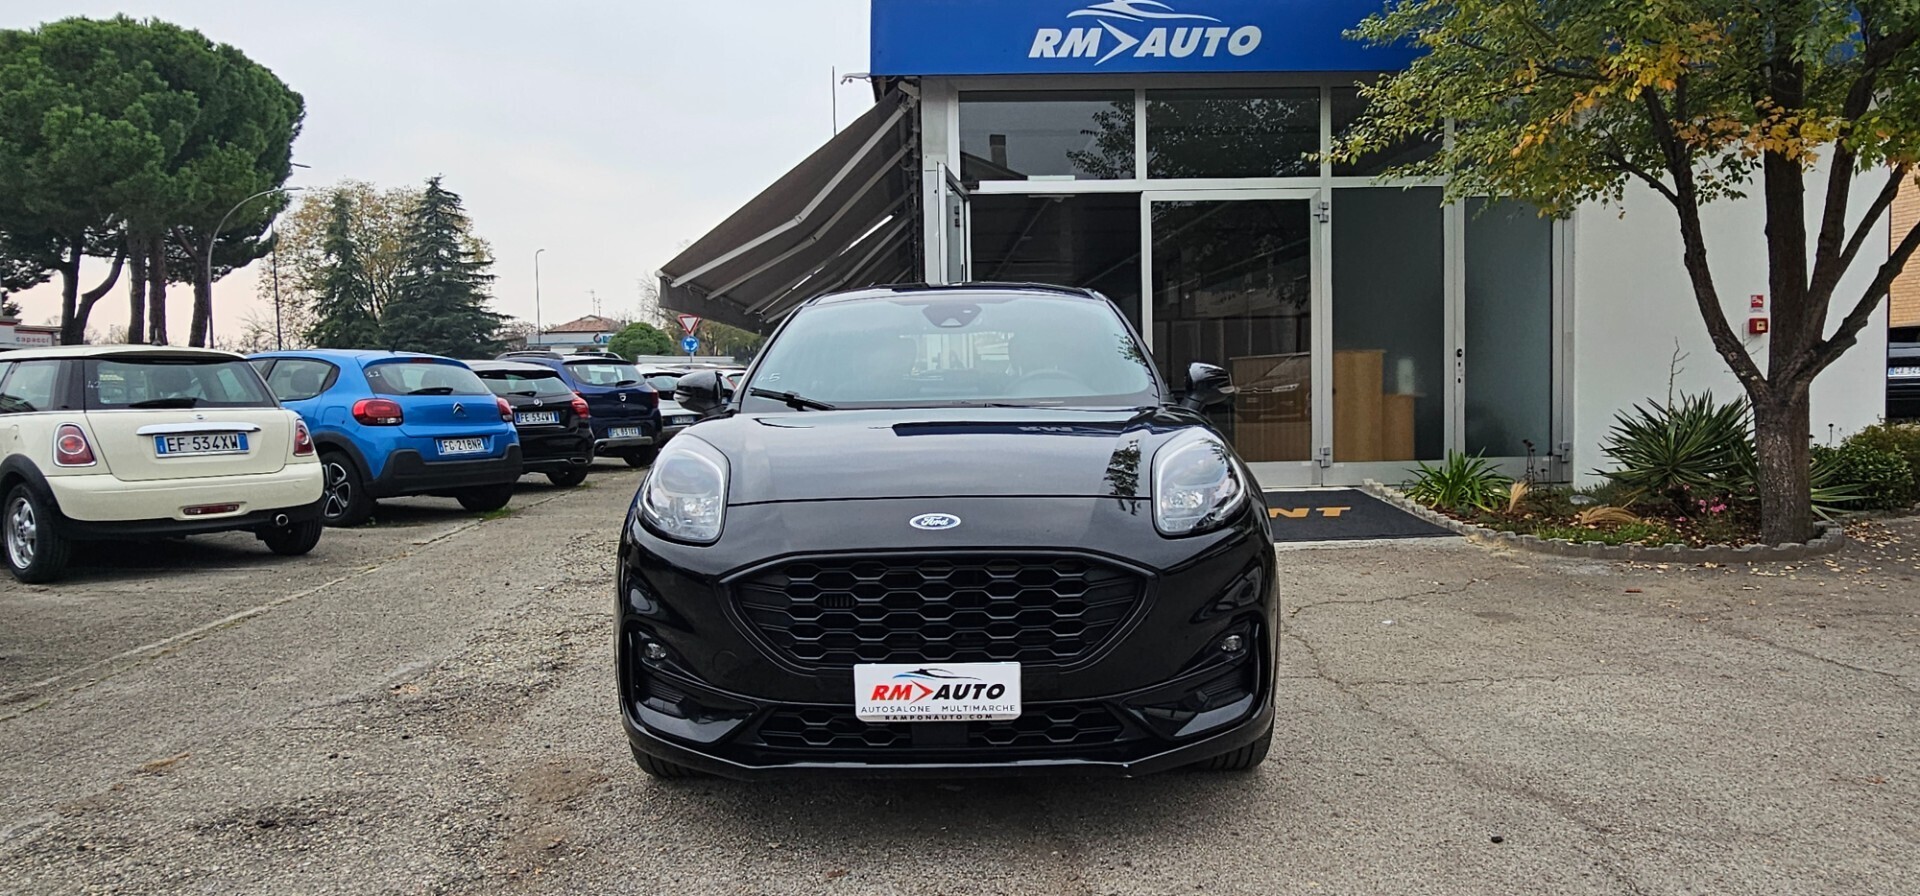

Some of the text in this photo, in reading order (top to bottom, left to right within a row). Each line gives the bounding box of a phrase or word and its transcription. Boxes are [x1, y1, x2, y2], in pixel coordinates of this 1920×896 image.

[1133, 25, 1262, 58] AUTO
[166, 435, 239, 452] EF 534XW
[932, 683, 1006, 701] AUTO
[860, 704, 1016, 714] AUTOSALONE MULTIMARCHE
